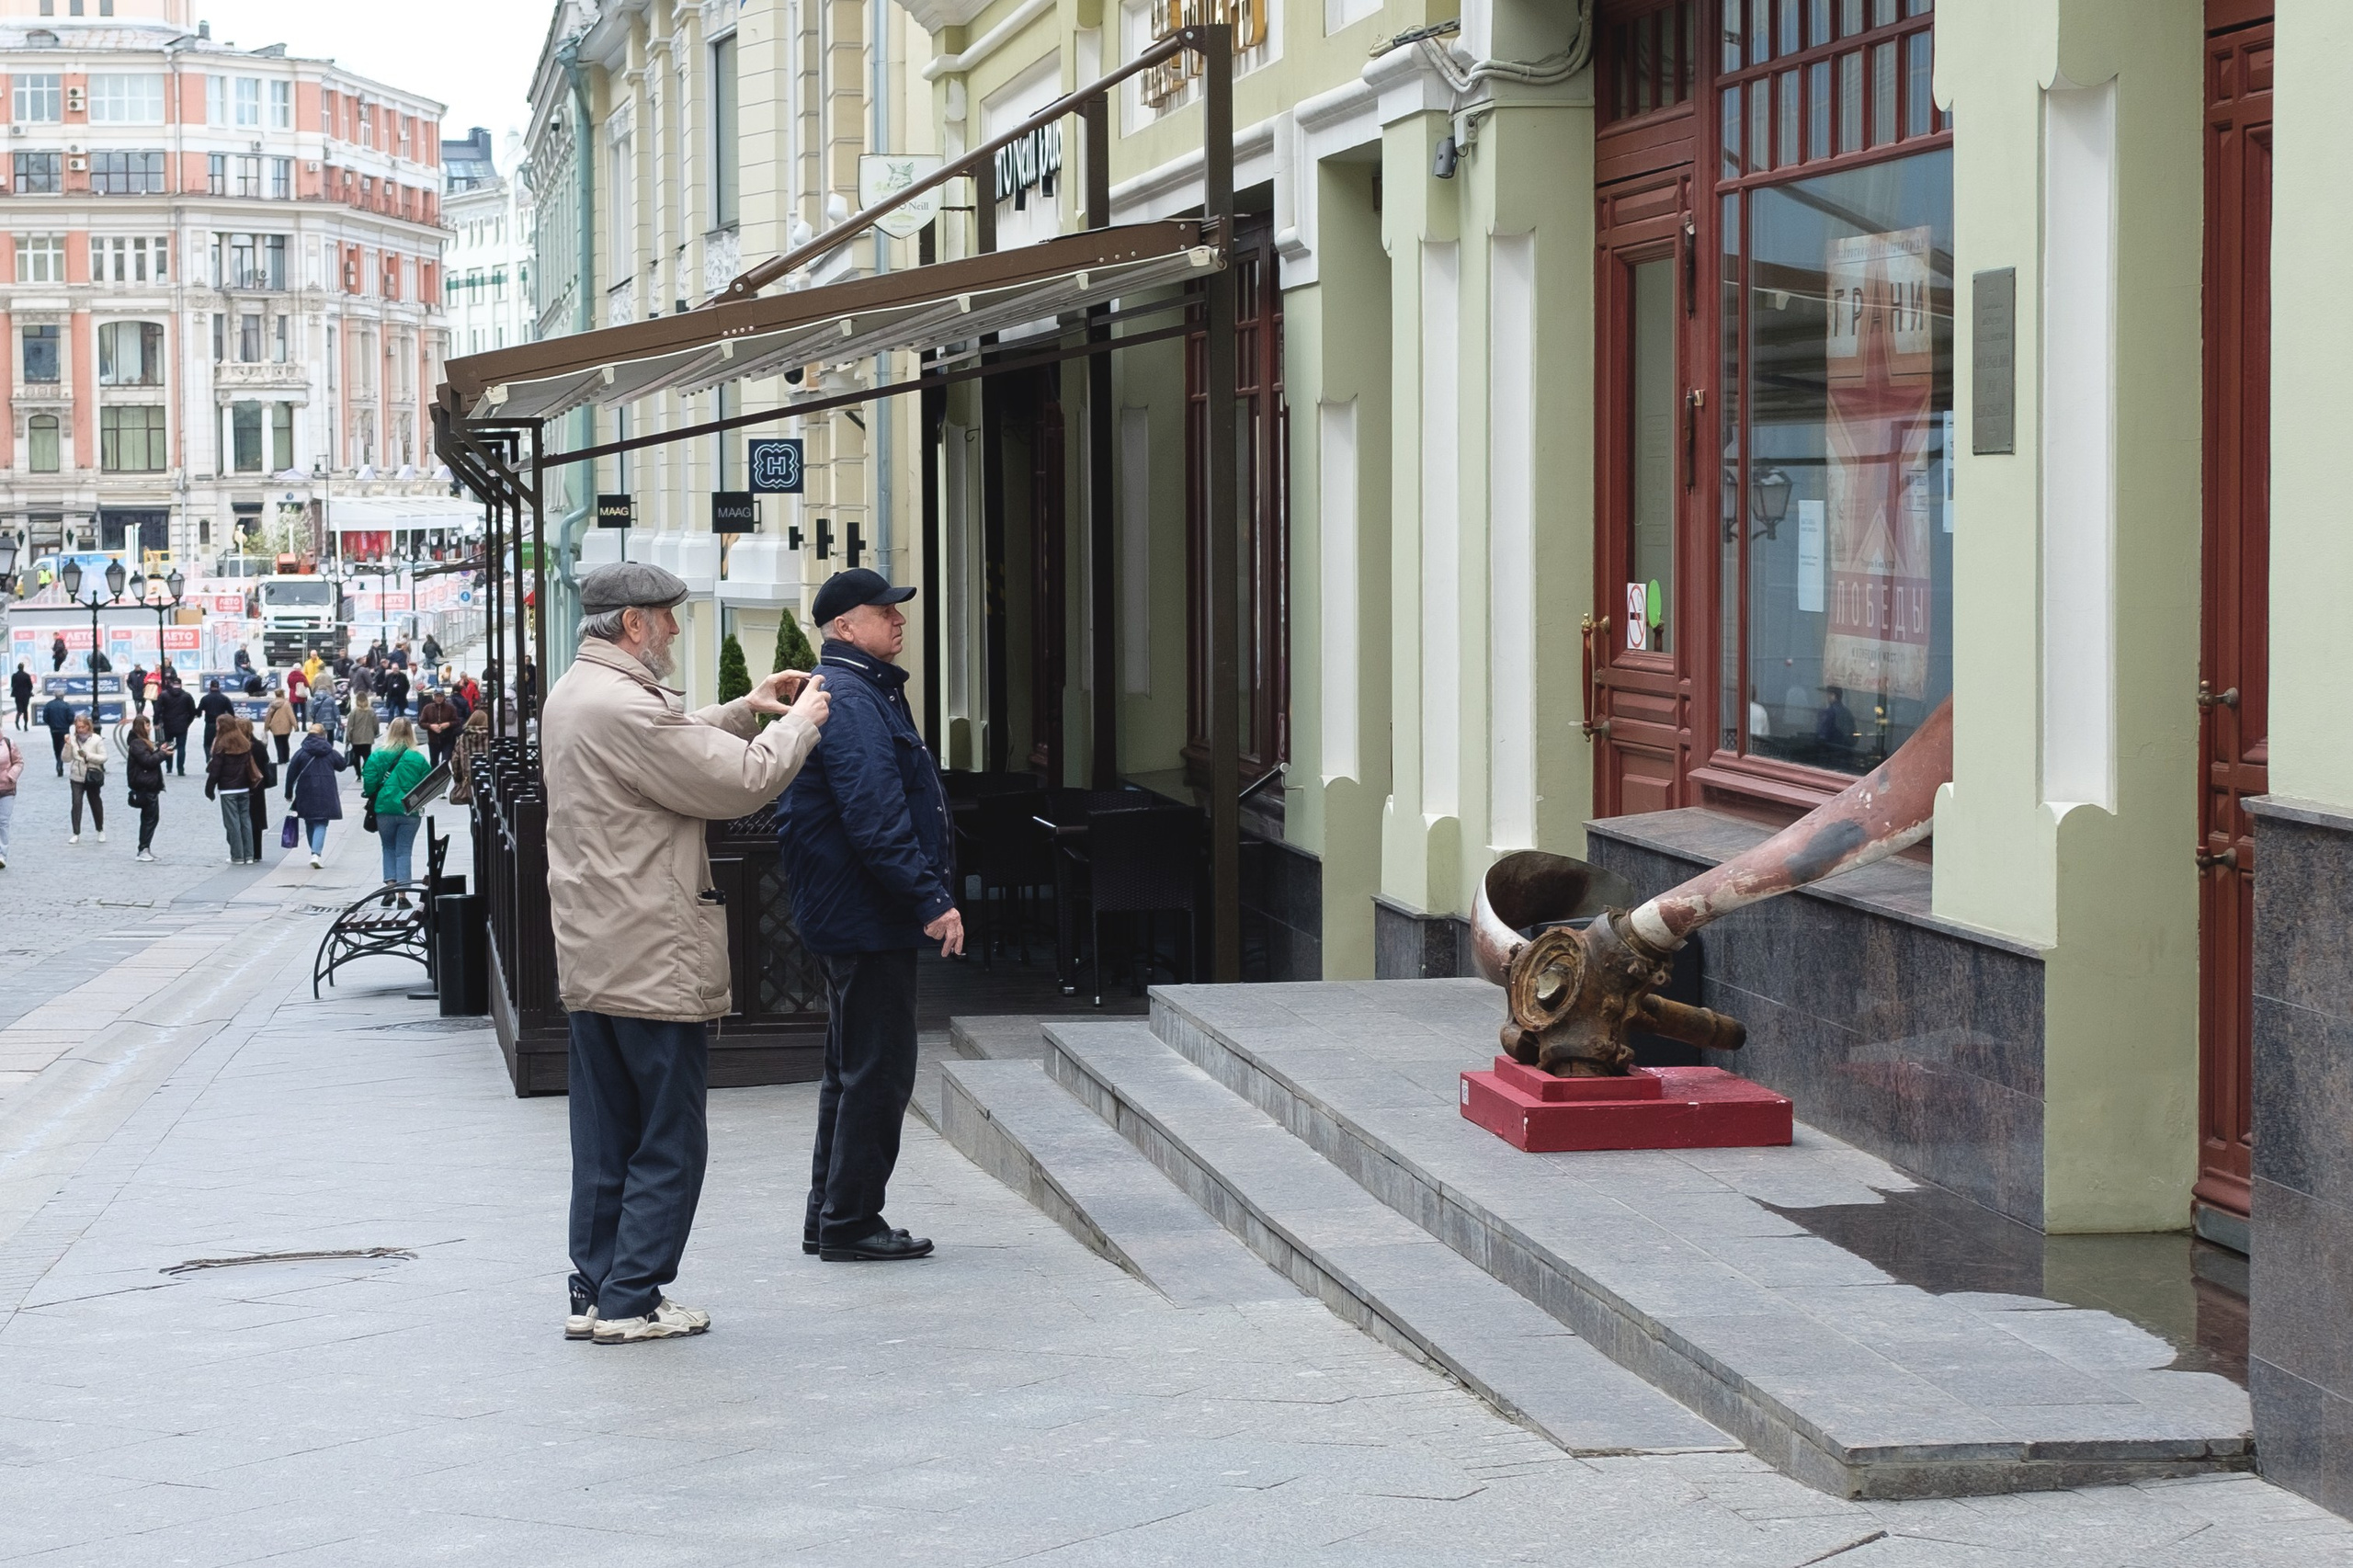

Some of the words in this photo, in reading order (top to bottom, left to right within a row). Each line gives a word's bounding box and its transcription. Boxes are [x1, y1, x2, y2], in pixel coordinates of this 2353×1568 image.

[1038, 119, 1063, 198] pub
[1834, 280, 1924, 337] ГРАНИ
[599, 506, 630, 517] MAAG
[718, 506, 752, 518] MAAG
[219, 597, 240, 606] ЛЕТО
[1836, 580, 1924, 641] ПОБЕДЫ
[163, 631, 194, 642] ЛЕТО
